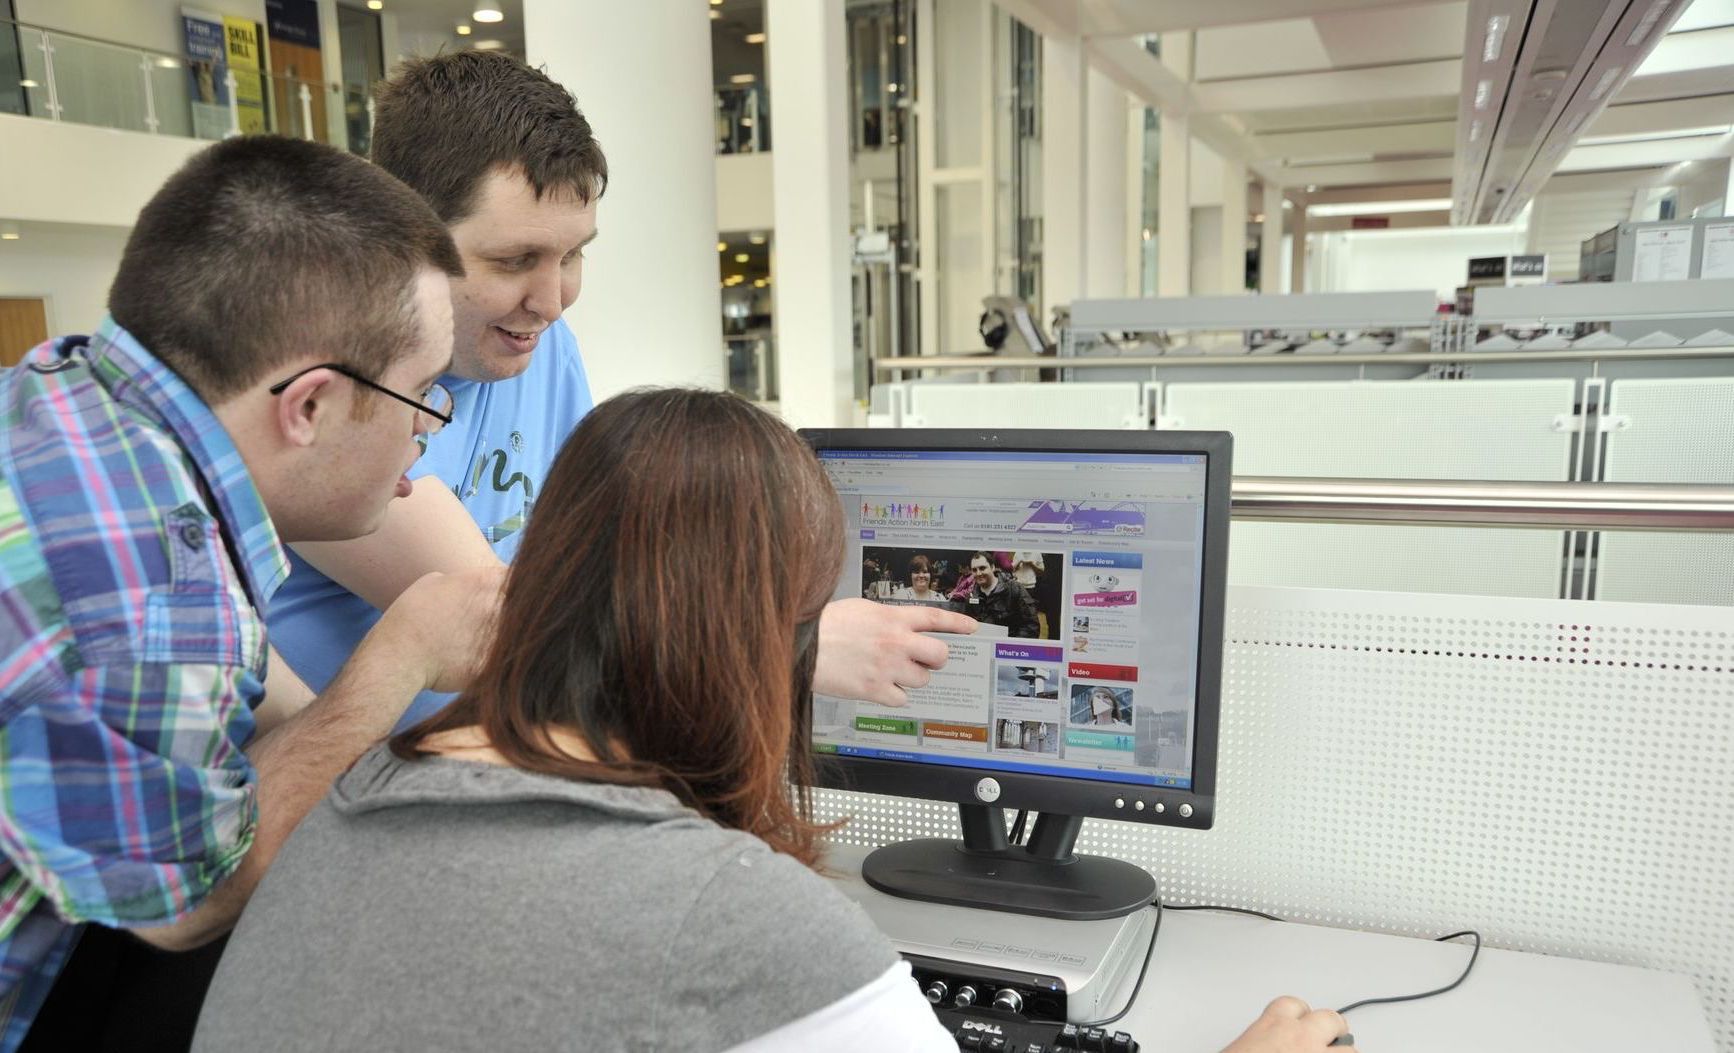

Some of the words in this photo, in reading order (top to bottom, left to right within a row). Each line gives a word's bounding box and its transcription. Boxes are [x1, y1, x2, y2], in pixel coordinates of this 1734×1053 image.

[228, 25, 256, 45] SKILL
[229, 42, 251, 59] BILL
[862, 518, 887, 526] Friends
[888, 519, 909, 527] Action
[910, 519, 929, 528] North
[930, 520, 945, 528] East
[1075, 557, 1096, 565] Latest
[1096, 558, 1115, 566] News
[998, 649, 1019, 658] What's
[1020, 650, 1030, 658] On
[1071, 668, 1090, 676] Video
[858, 723, 881, 731] Meeting
[925, 728, 958, 738] Community
[960, 731, 973, 740] Map
[962, 1020, 1003, 1035] DELL
